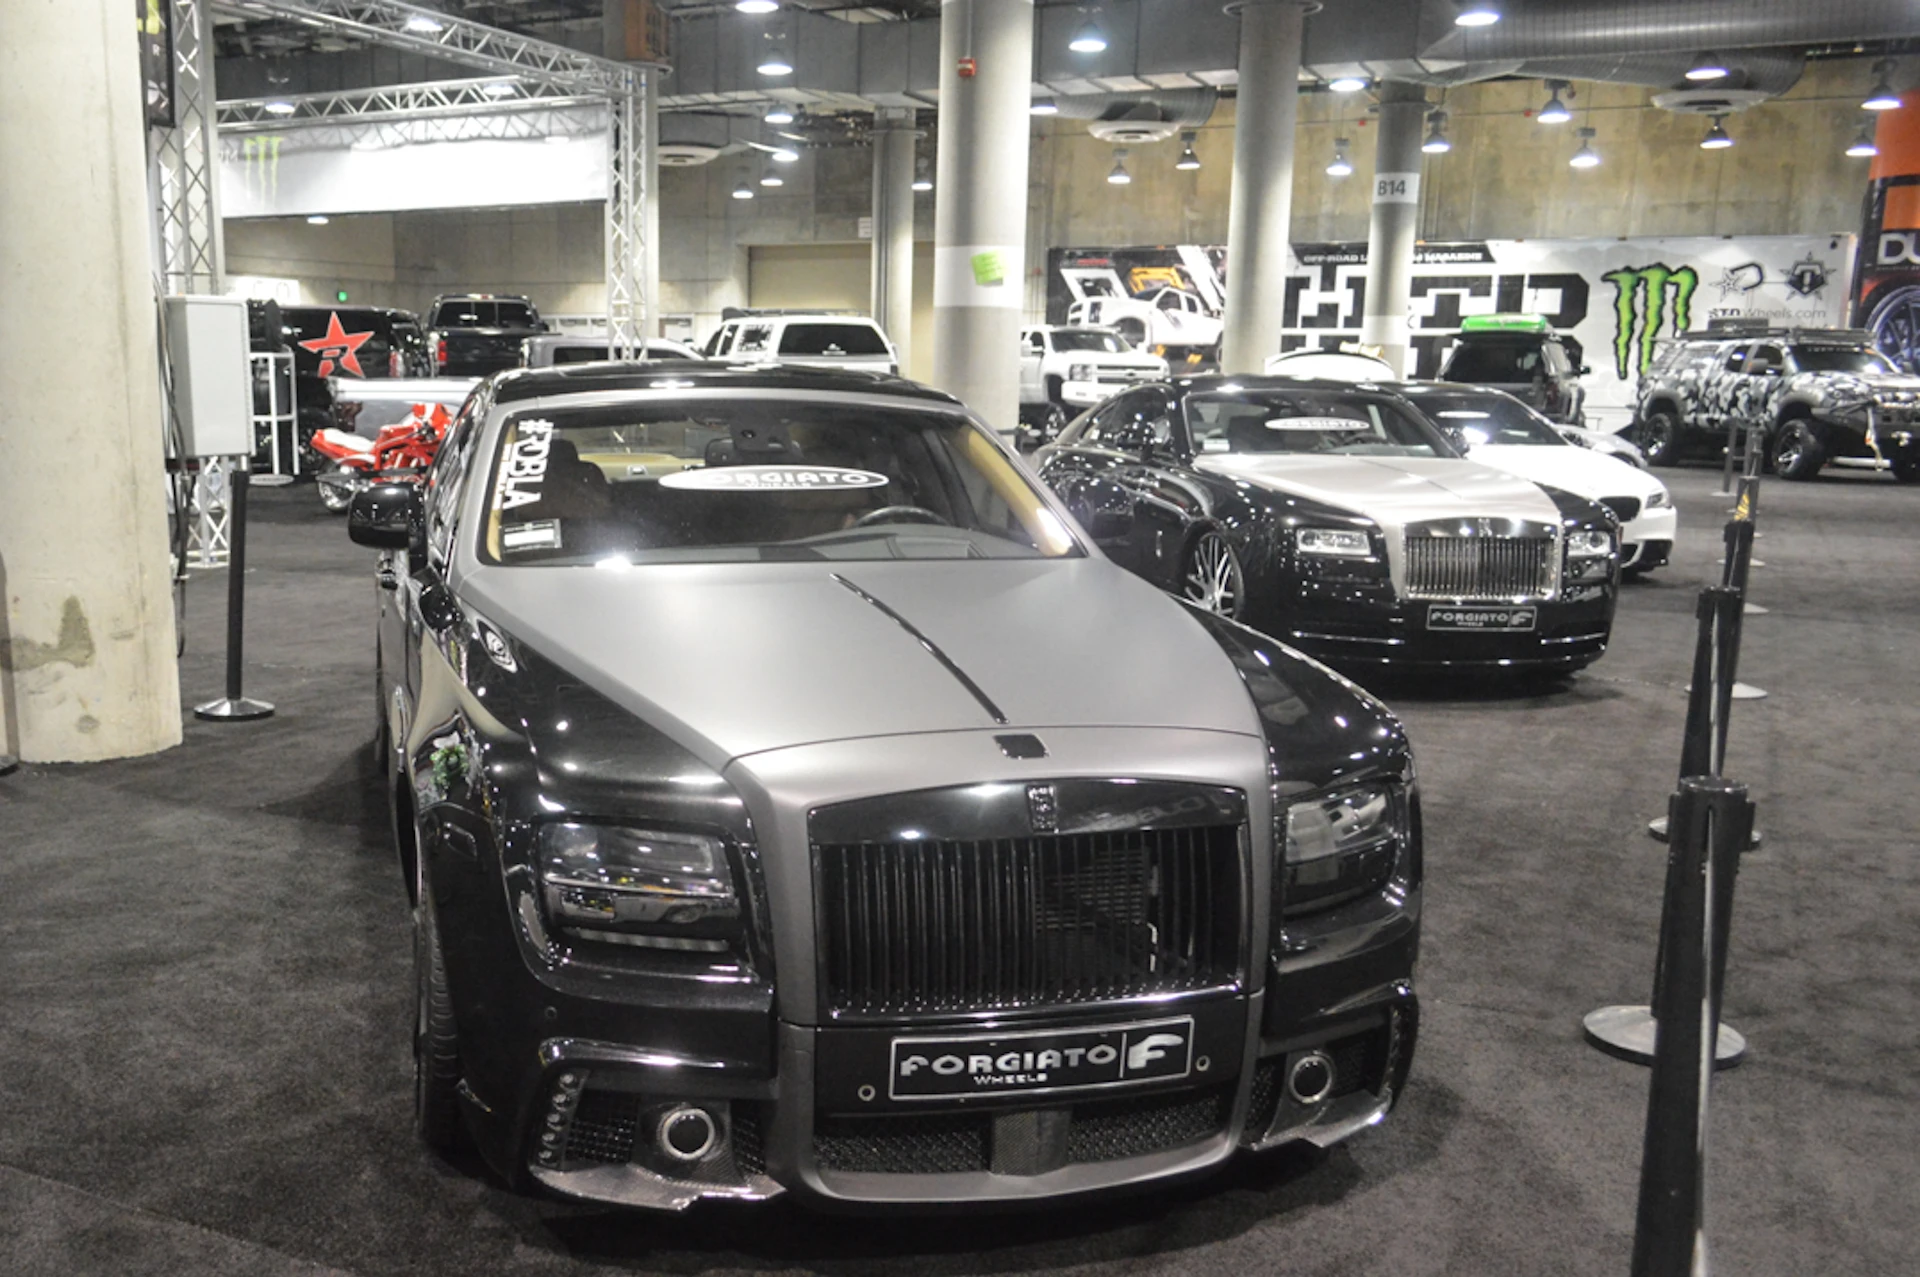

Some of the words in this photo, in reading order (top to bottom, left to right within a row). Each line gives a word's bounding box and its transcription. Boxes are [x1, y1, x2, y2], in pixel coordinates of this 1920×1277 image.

[1377, 179, 1406, 197] B14
[687, 471, 869, 485] ORGIATO
[1430, 611, 1509, 622] FORGIATO
[900, 1044, 1118, 1077] FORGIATO
[1127, 1033, 1185, 1070] F
[973, 1073, 1048, 1086] WHEELS
